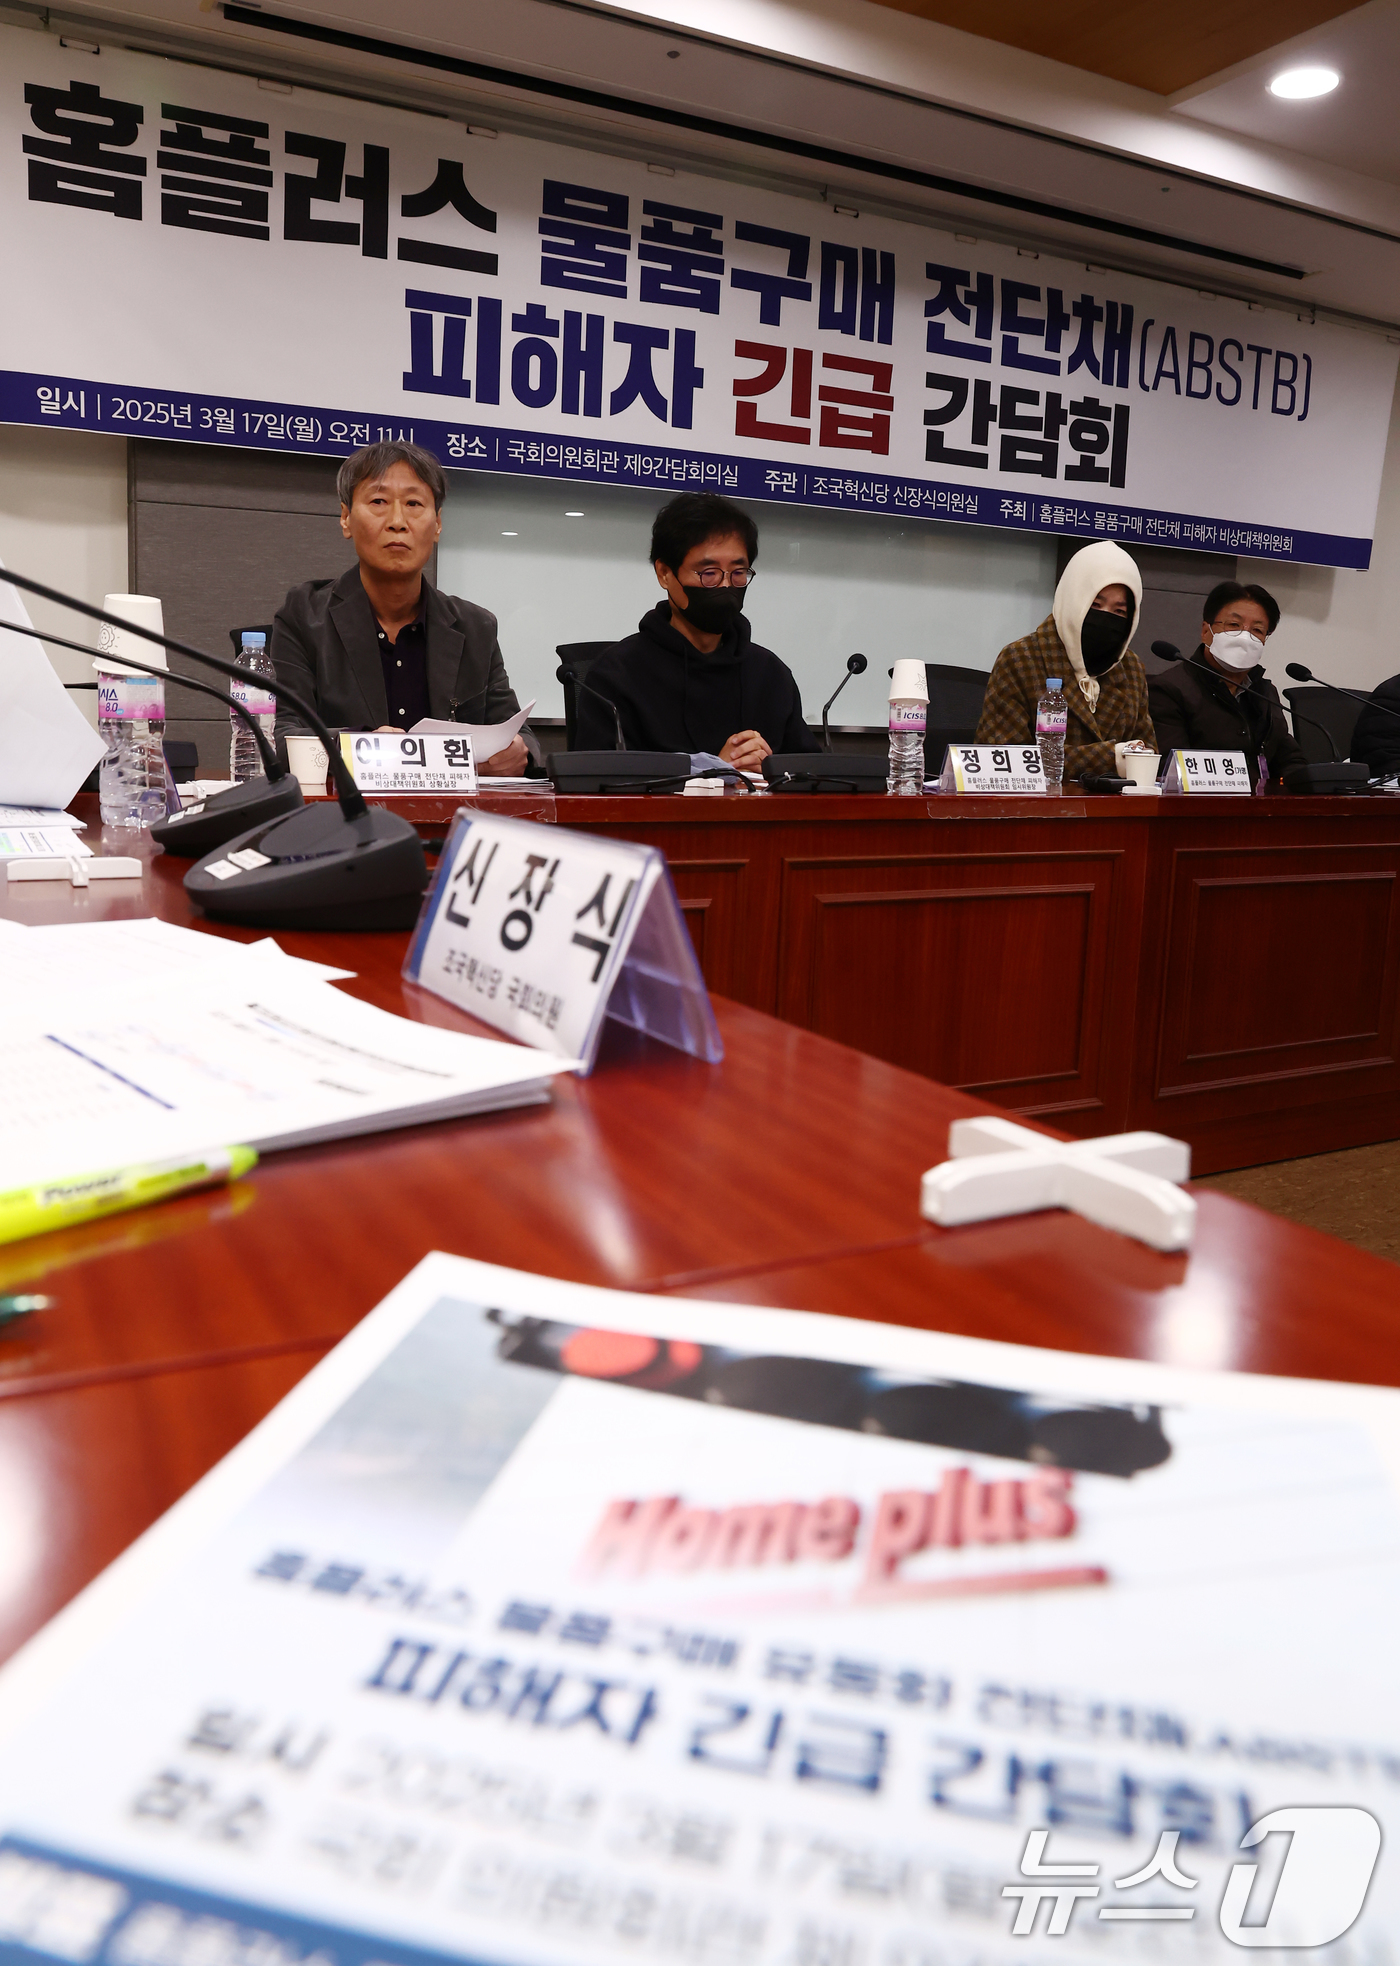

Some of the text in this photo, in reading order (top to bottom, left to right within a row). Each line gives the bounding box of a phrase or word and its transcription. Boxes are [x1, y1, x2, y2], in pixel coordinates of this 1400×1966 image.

[22, 80, 1312, 421] 홈플러스 물품구매 전단채(ABSTB)
[402, 288, 1130, 488] 피해자 긴급 간담회
[36, 386, 86, 418] 일시
[111, 397, 192, 429] 2025년
[199, 407, 235, 434] 3월
[242, 412, 322, 443] 17일(월)
[328, 421, 370, 447] 오전
[446, 433, 487, 458] 장소
[506, 439, 620, 474] 국회의원회관
[623, 452, 739, 487] 제9간담회의실
[764, 469, 798, 494] 주관
[812, 476, 889, 503] 조국혁신당
[893, 486, 979, 515] 신장식의원실
[999, 498, 1027, 521] 주최
[1039, 503, 1091, 527] 홈플러스
[1093, 511, 1143, 534] 물품구매
[1145, 517, 1180, 539] 전단채
[1182, 523, 1217, 544] 피해자
[1219, 527, 1294, 554] 비상대책위원회
[360, 772, 389, 780] 홈플러스
[449, 772, 470, 780] 피해자
[375, 780, 426, 788] 비상대책위원회
[442, 948, 503, 1000] 조국혁신당
[363, 1636, 658, 1747] 피해자
[687, 1692, 890, 1794] 긴급
